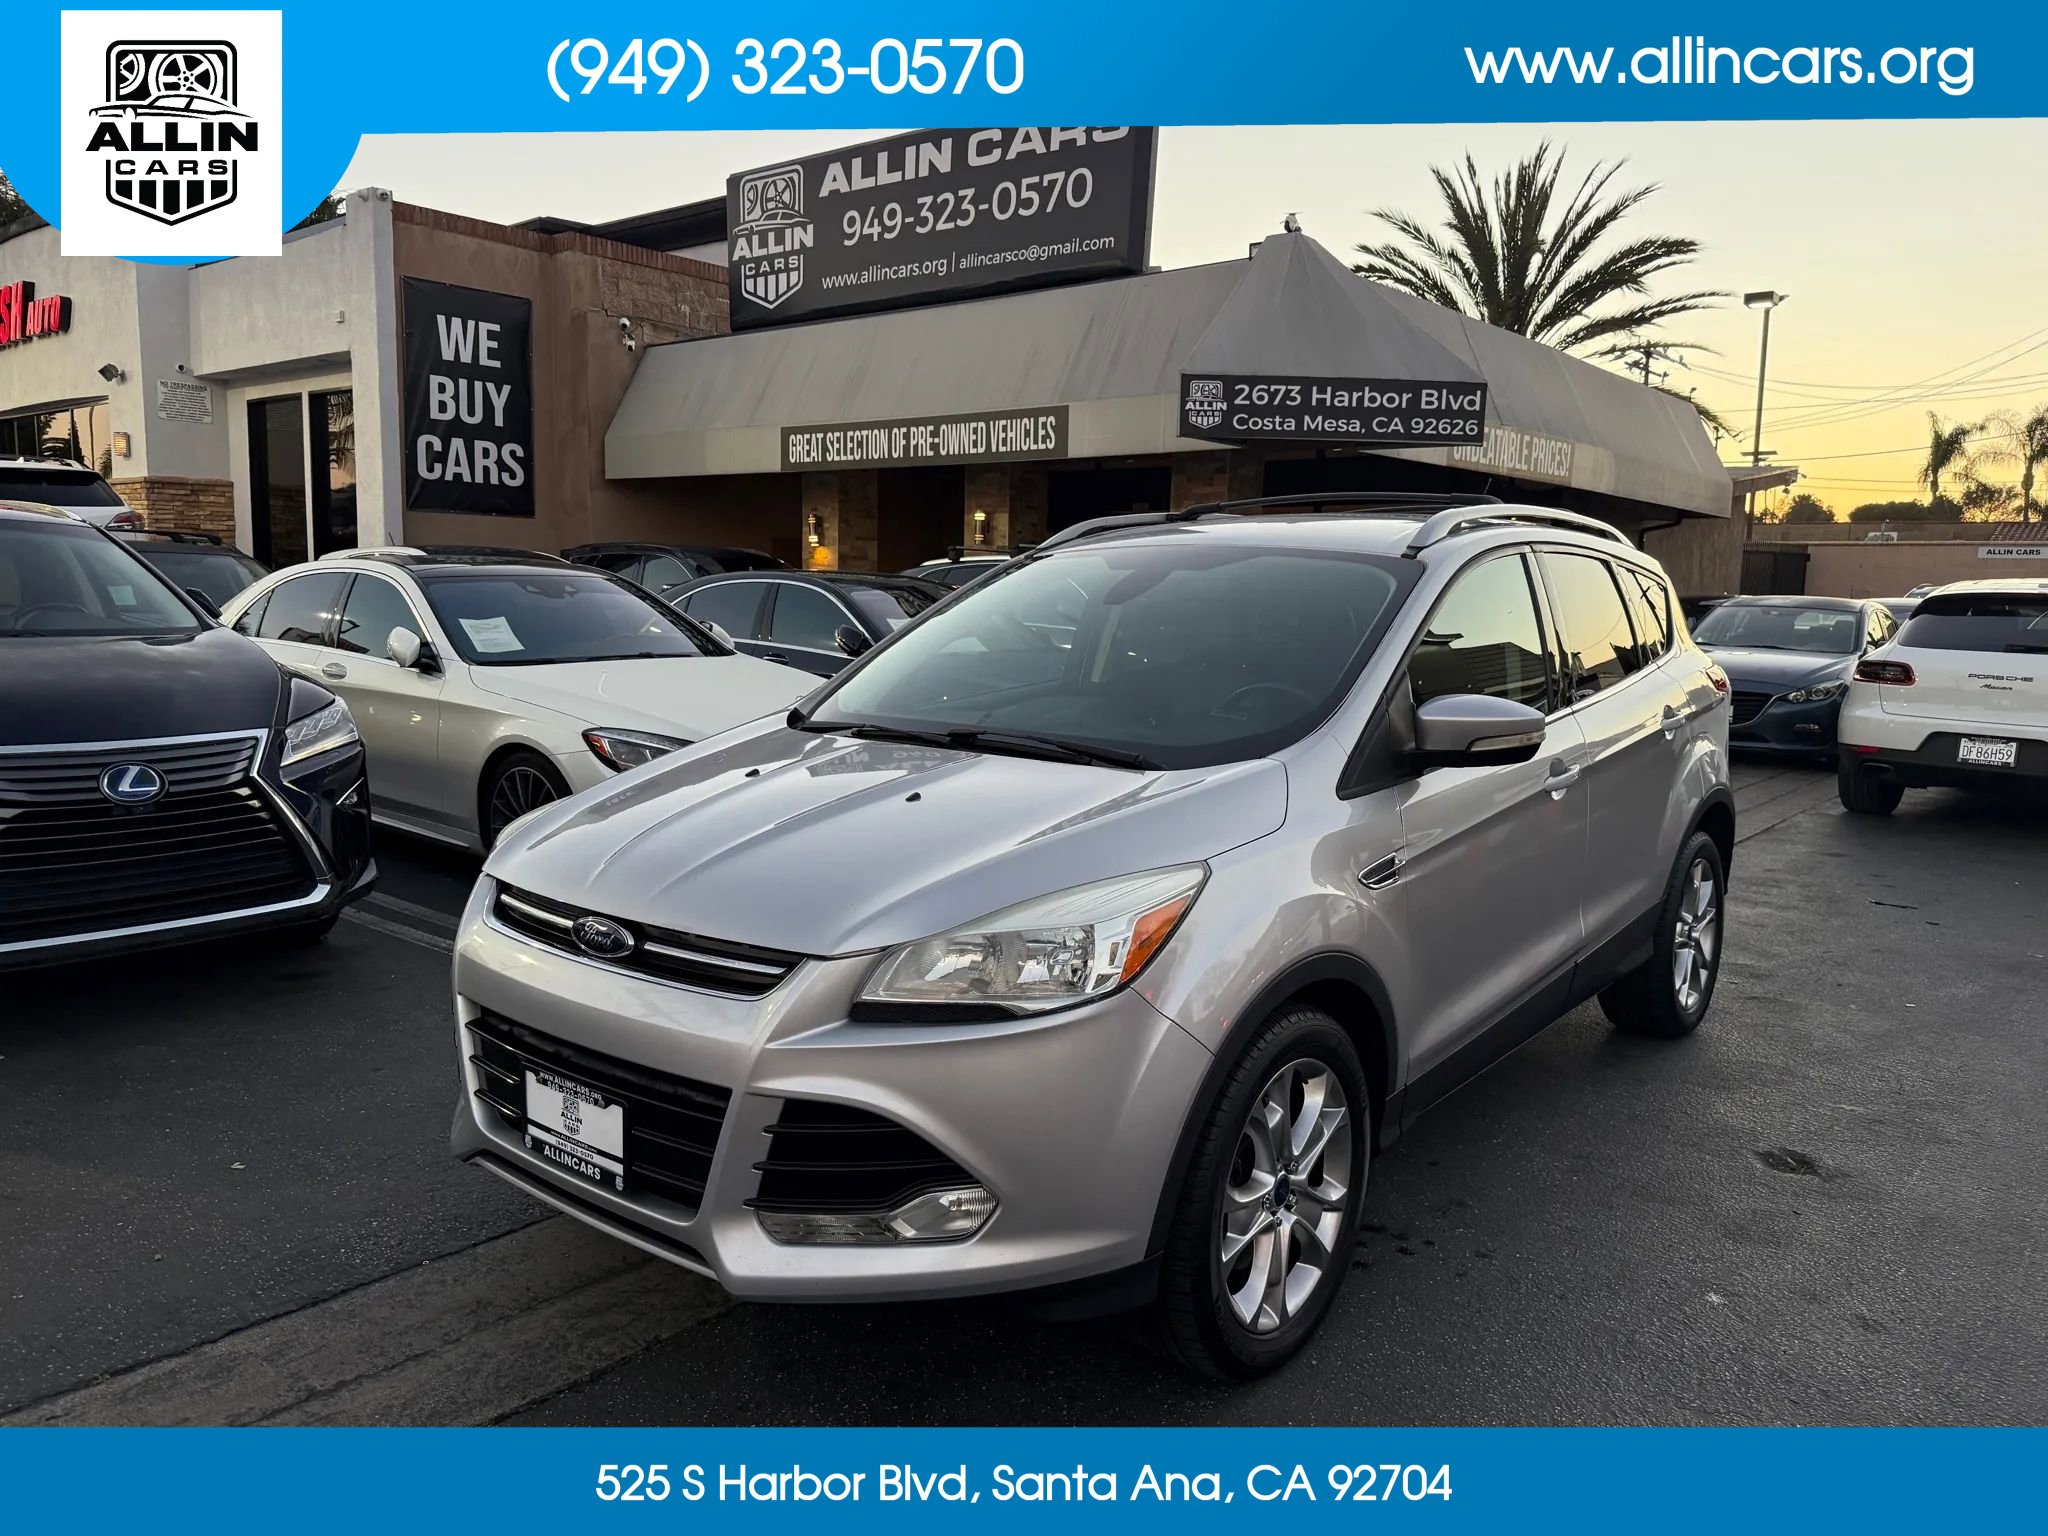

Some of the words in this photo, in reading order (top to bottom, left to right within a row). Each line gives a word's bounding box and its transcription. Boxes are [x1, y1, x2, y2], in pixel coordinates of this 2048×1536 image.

[819, 138, 952, 198] ALLIN
[842, 167, 1093, 246] 949-323-0570
[732, 224, 814, 261] ALLIN
[745, 256, 799, 275] CARS
[821, 257, 947, 290] www.allincars.org
[959, 235, 1115, 270] allincarsco@gmail.com
[26, 295, 61, 336] AUTO
[436, 314, 502, 368] WE
[429, 374, 512, 427] BUY
[1185, 401, 1227, 410] ALLIN
[1233, 384, 1302, 406] 2673
[1311, 386, 1413, 409] Harbor
[1420, 389, 1482, 412] Blvd
[789, 433, 824, 463] GREAT
[826, 428, 889, 461] SELECTION
[891, 427, 907, 458] OF
[910, 421, 987, 458] PRE-OWNED
[990, 415, 1056, 452] VEHICLES
[1232, 413, 1296, 431] Costa
[1303, 415, 1366, 434] Mesa,
[1372, 417, 1404, 434] CA
[1410, 418, 1478, 436] 92626
[416, 434, 525, 487] CARS
[1530, 436, 1572, 478] PRICES!
[1968, 674, 2034, 682] PORSCHE
[1961, 745, 2013, 761] DF86H59
[1968, 759, 2002, 767] ALLINCARS
[560, 1111, 583, 1125] ALLIN
[544, 1145, 601, 1180] ALLINCARS
